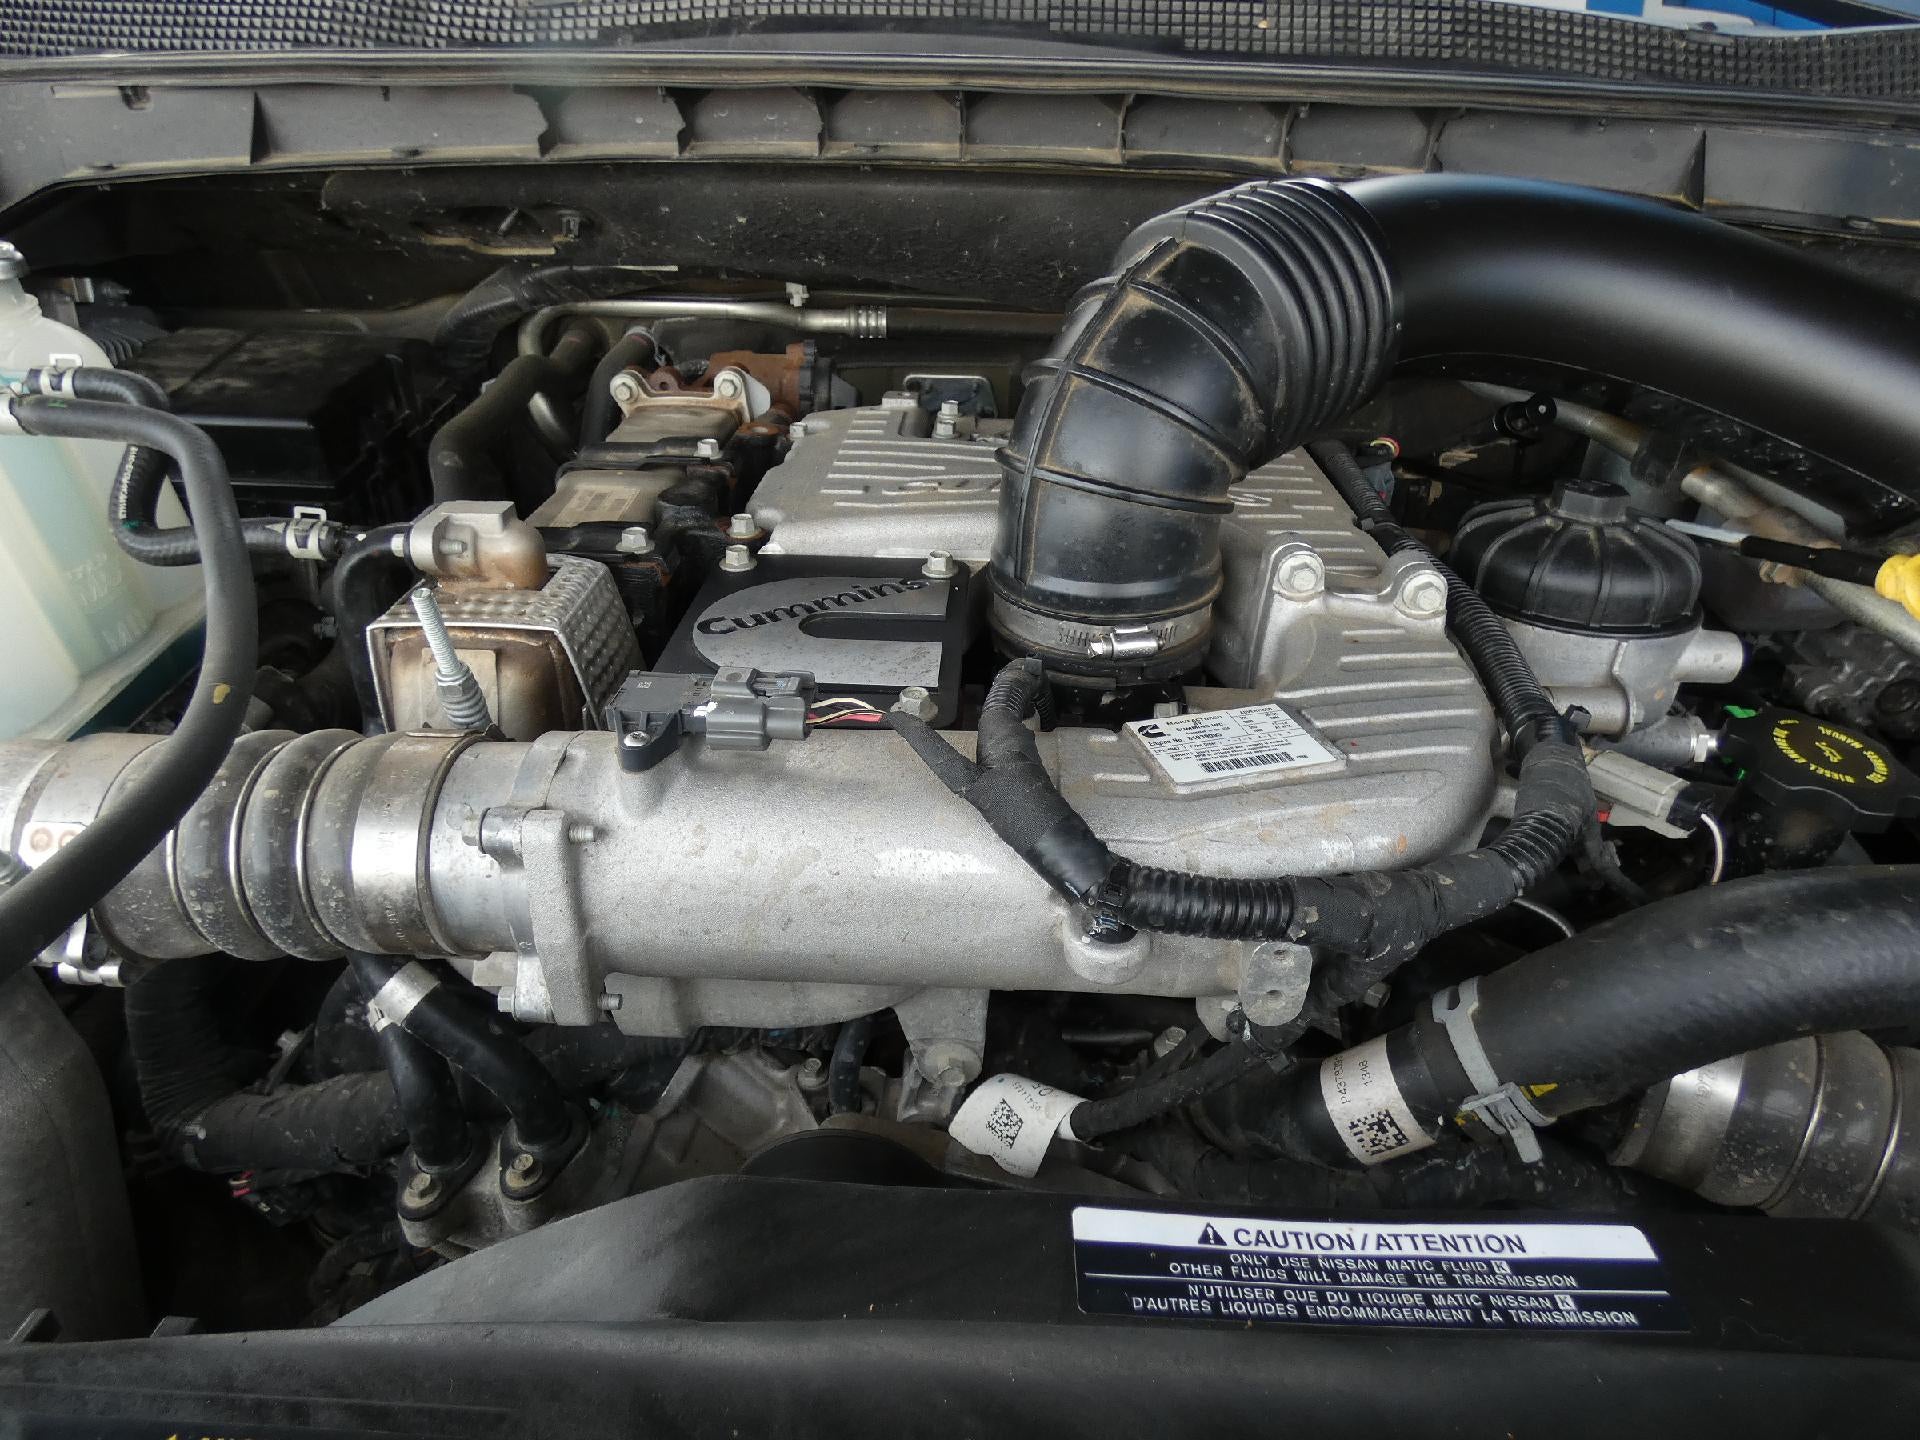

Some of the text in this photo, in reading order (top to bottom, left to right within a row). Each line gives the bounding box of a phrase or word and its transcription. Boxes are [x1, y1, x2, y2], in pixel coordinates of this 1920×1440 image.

[696, 577, 930, 635] Cummins
[1233, 1228, 1355, 1251] CAUTION
[1375, 1232, 1527, 1254] ATTENTION
[1169, 1262, 1578, 1288] OTHER FLUIDS WILL DAMAGE THE TRANSMISSION
[1229, 1253, 1269, 1265] ONLY
[1278, 1257, 1311, 1268] USE
[1318, 1257, 1379, 1270] NISSAN
[1386, 1259, 1434, 1272] MATIC
[1442, 1260, 1487, 1272] FLUID
[1188, 1284, 1276, 1301] N'UTILISER
[1283, 1289, 1319, 1302] QUE
[1326, 1291, 1350, 1303] DU
[1358, 1292, 1426, 1306] LIQUIDE
[1432, 1293, 1482, 1307] MATIC
[1489, 1294, 1554, 1309] NISSAN
[1133, 1296, 1639, 1326] D'AUTRES LIQUIDES ENDOMMAGERAIENT LA TRANSMISSION
